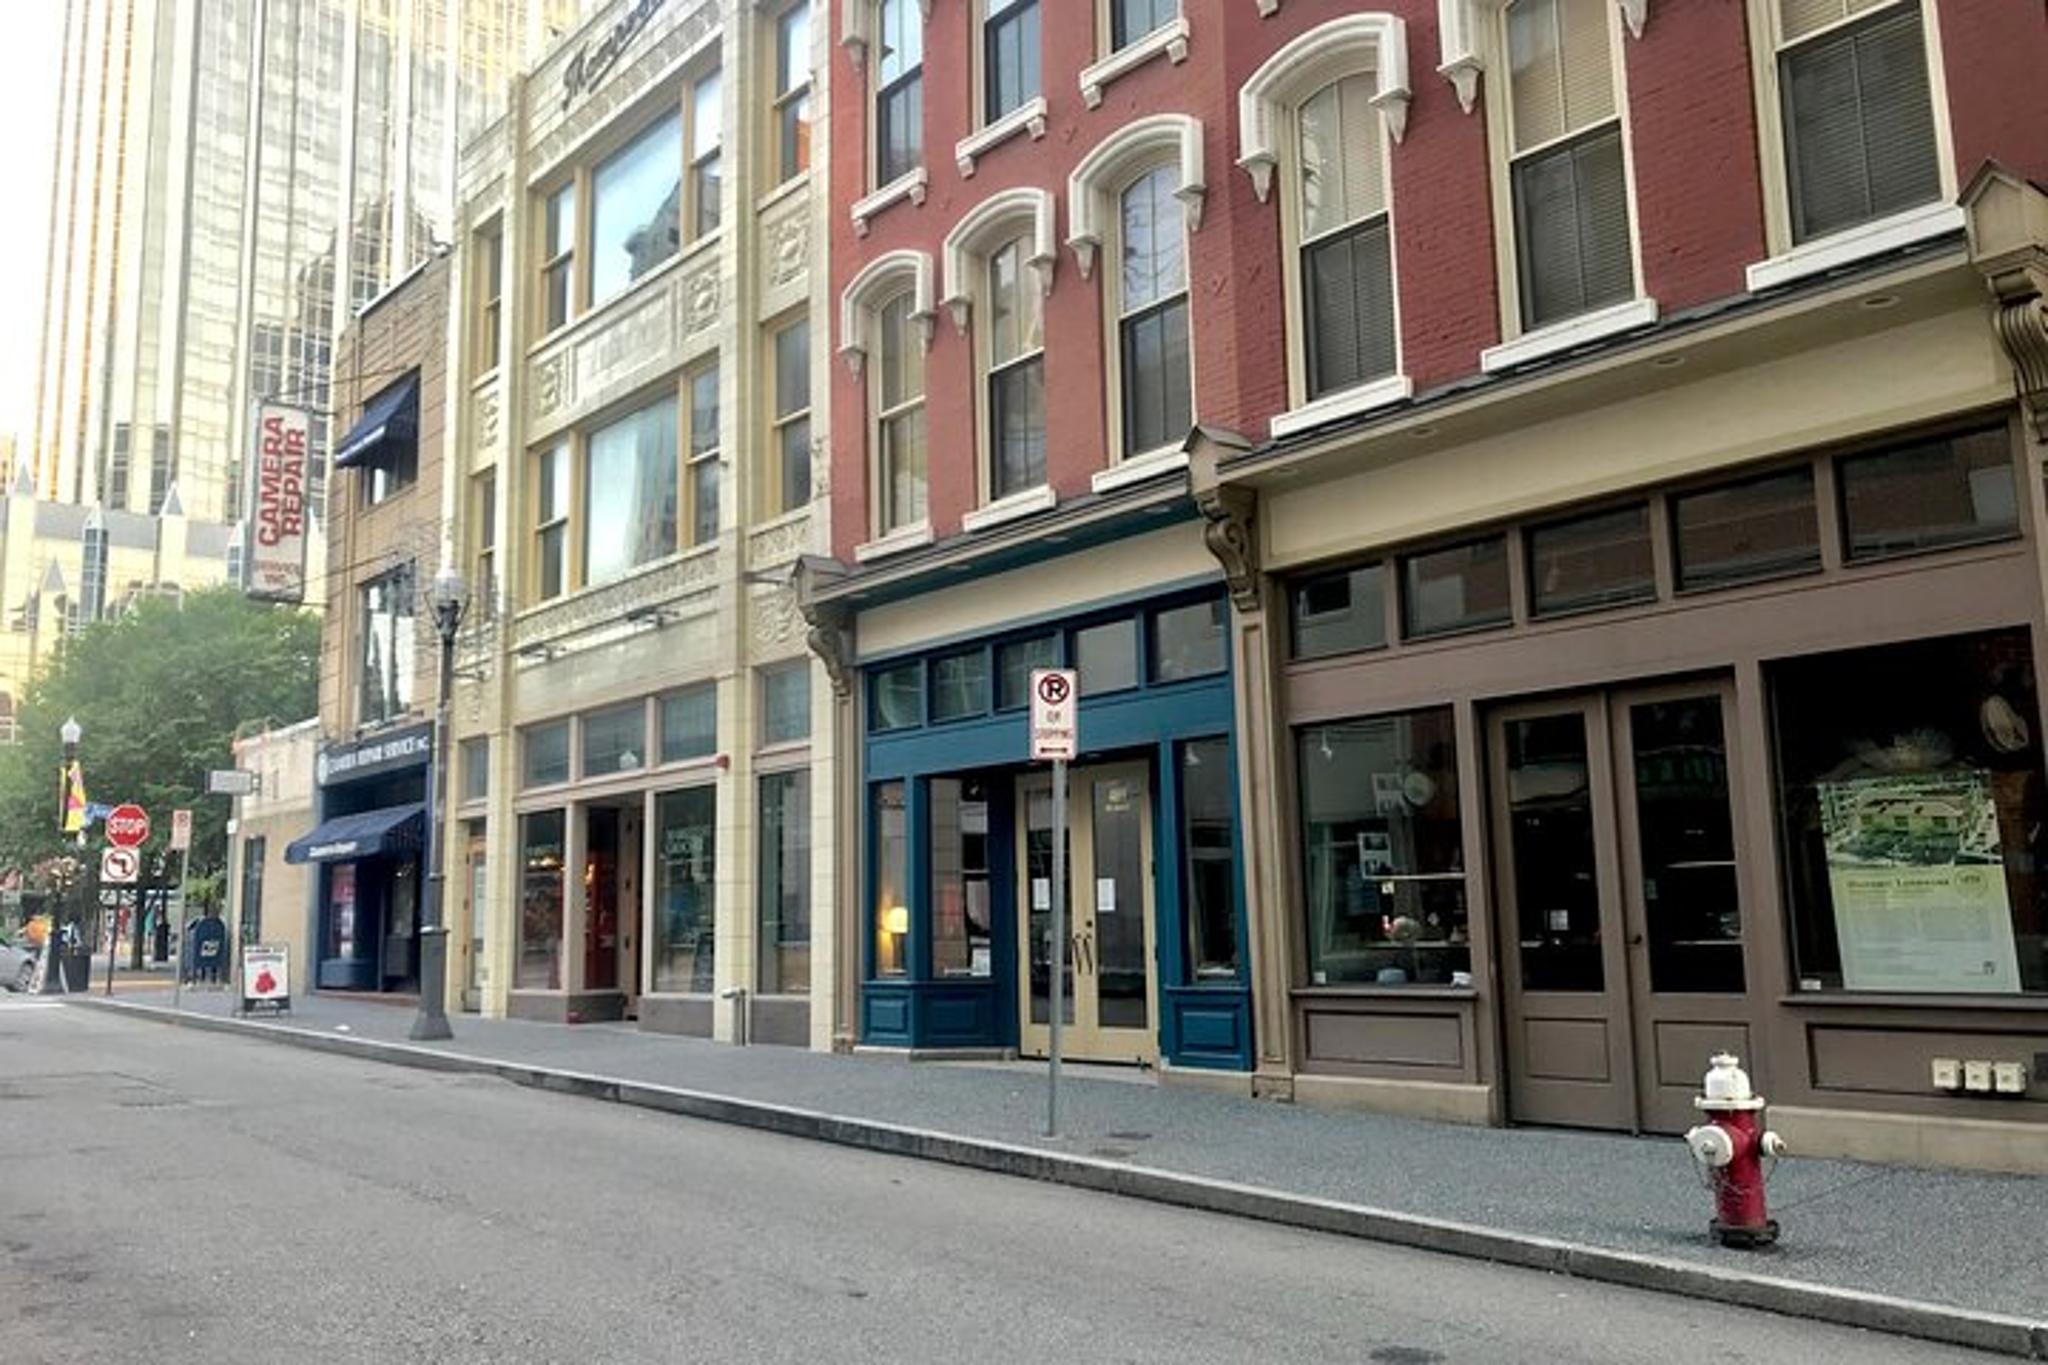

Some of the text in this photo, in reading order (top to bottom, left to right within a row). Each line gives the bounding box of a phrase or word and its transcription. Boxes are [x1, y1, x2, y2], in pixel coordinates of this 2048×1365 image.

[258, 416, 284, 547] CAMERA
[280, 429, 306, 536] REPAIR
[109, 818, 147, 834] STOP
